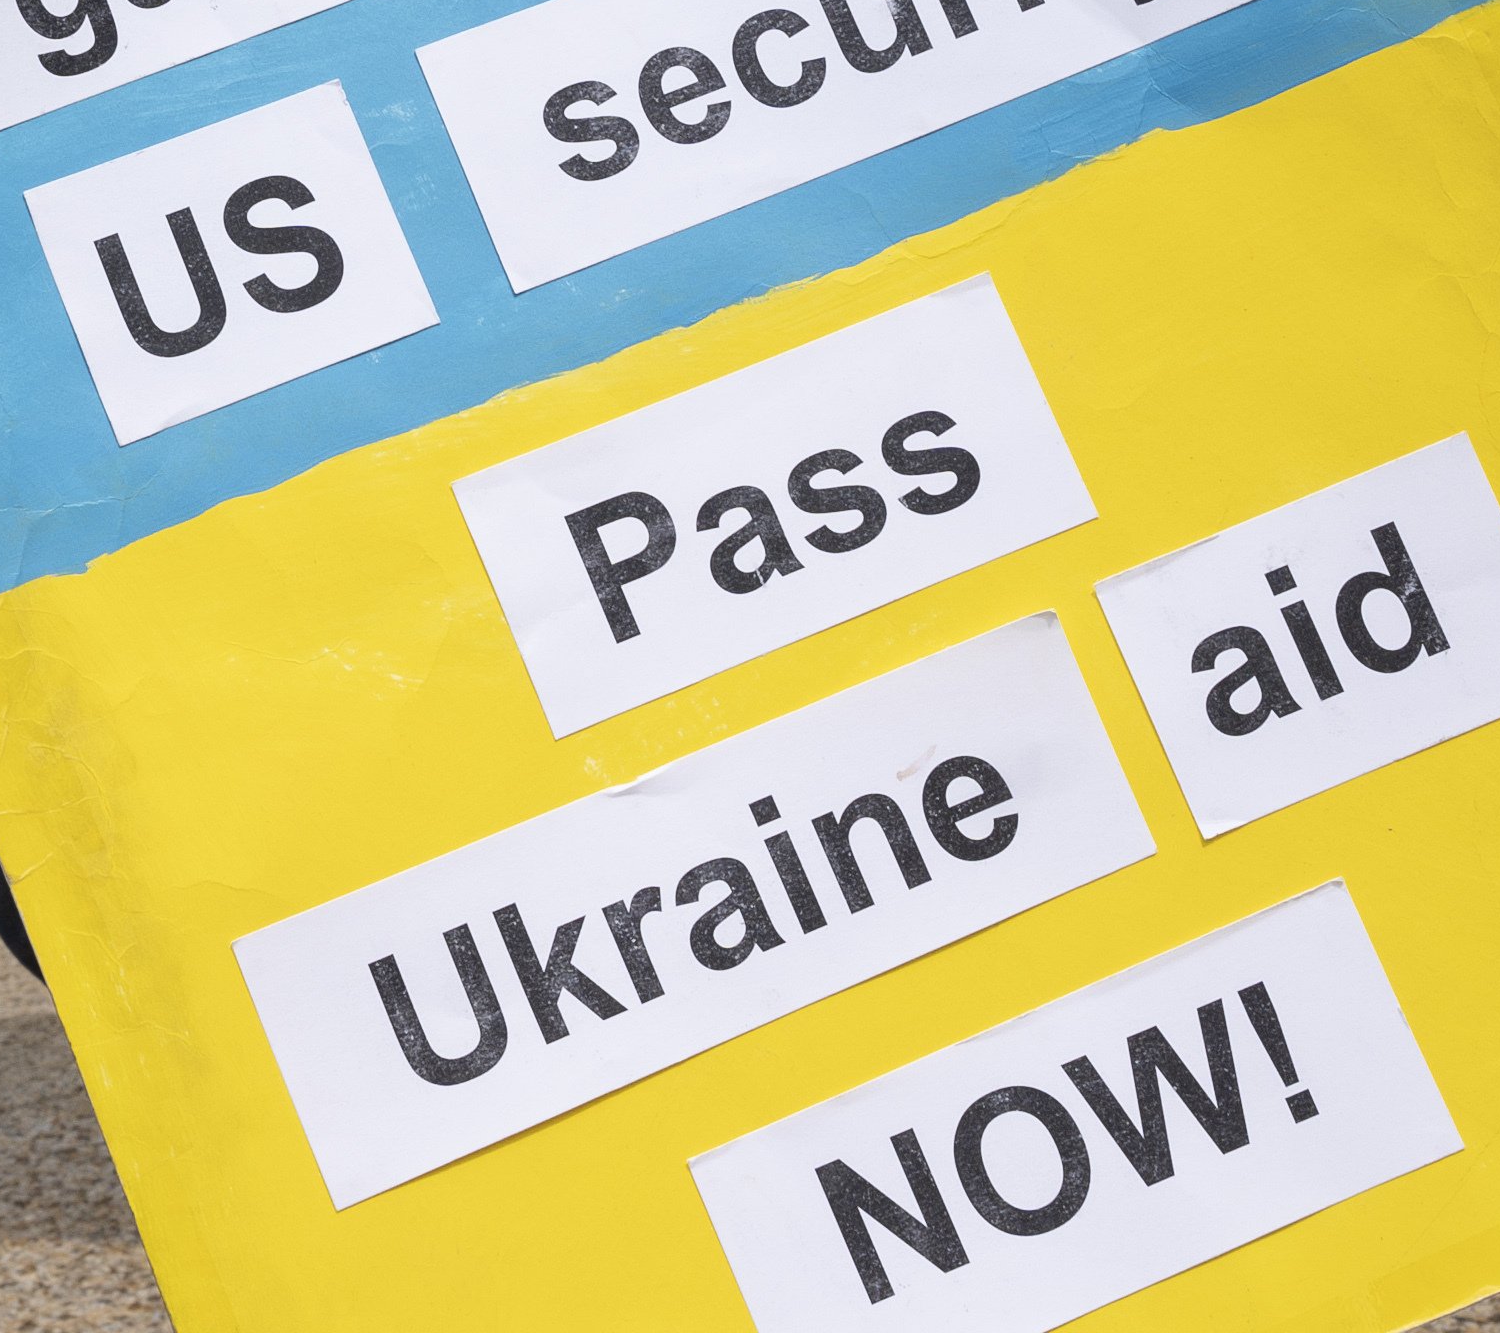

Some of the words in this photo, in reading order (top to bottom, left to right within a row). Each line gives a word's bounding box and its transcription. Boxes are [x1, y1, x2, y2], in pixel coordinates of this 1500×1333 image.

[92, 174, 346, 359] US
[563, 409, 983, 645] Pass
[367, 754, 1021, 1087] Ukraine
[1190, 520, 1453, 738] aid
[813, 980, 1321, 1304] NOW!
